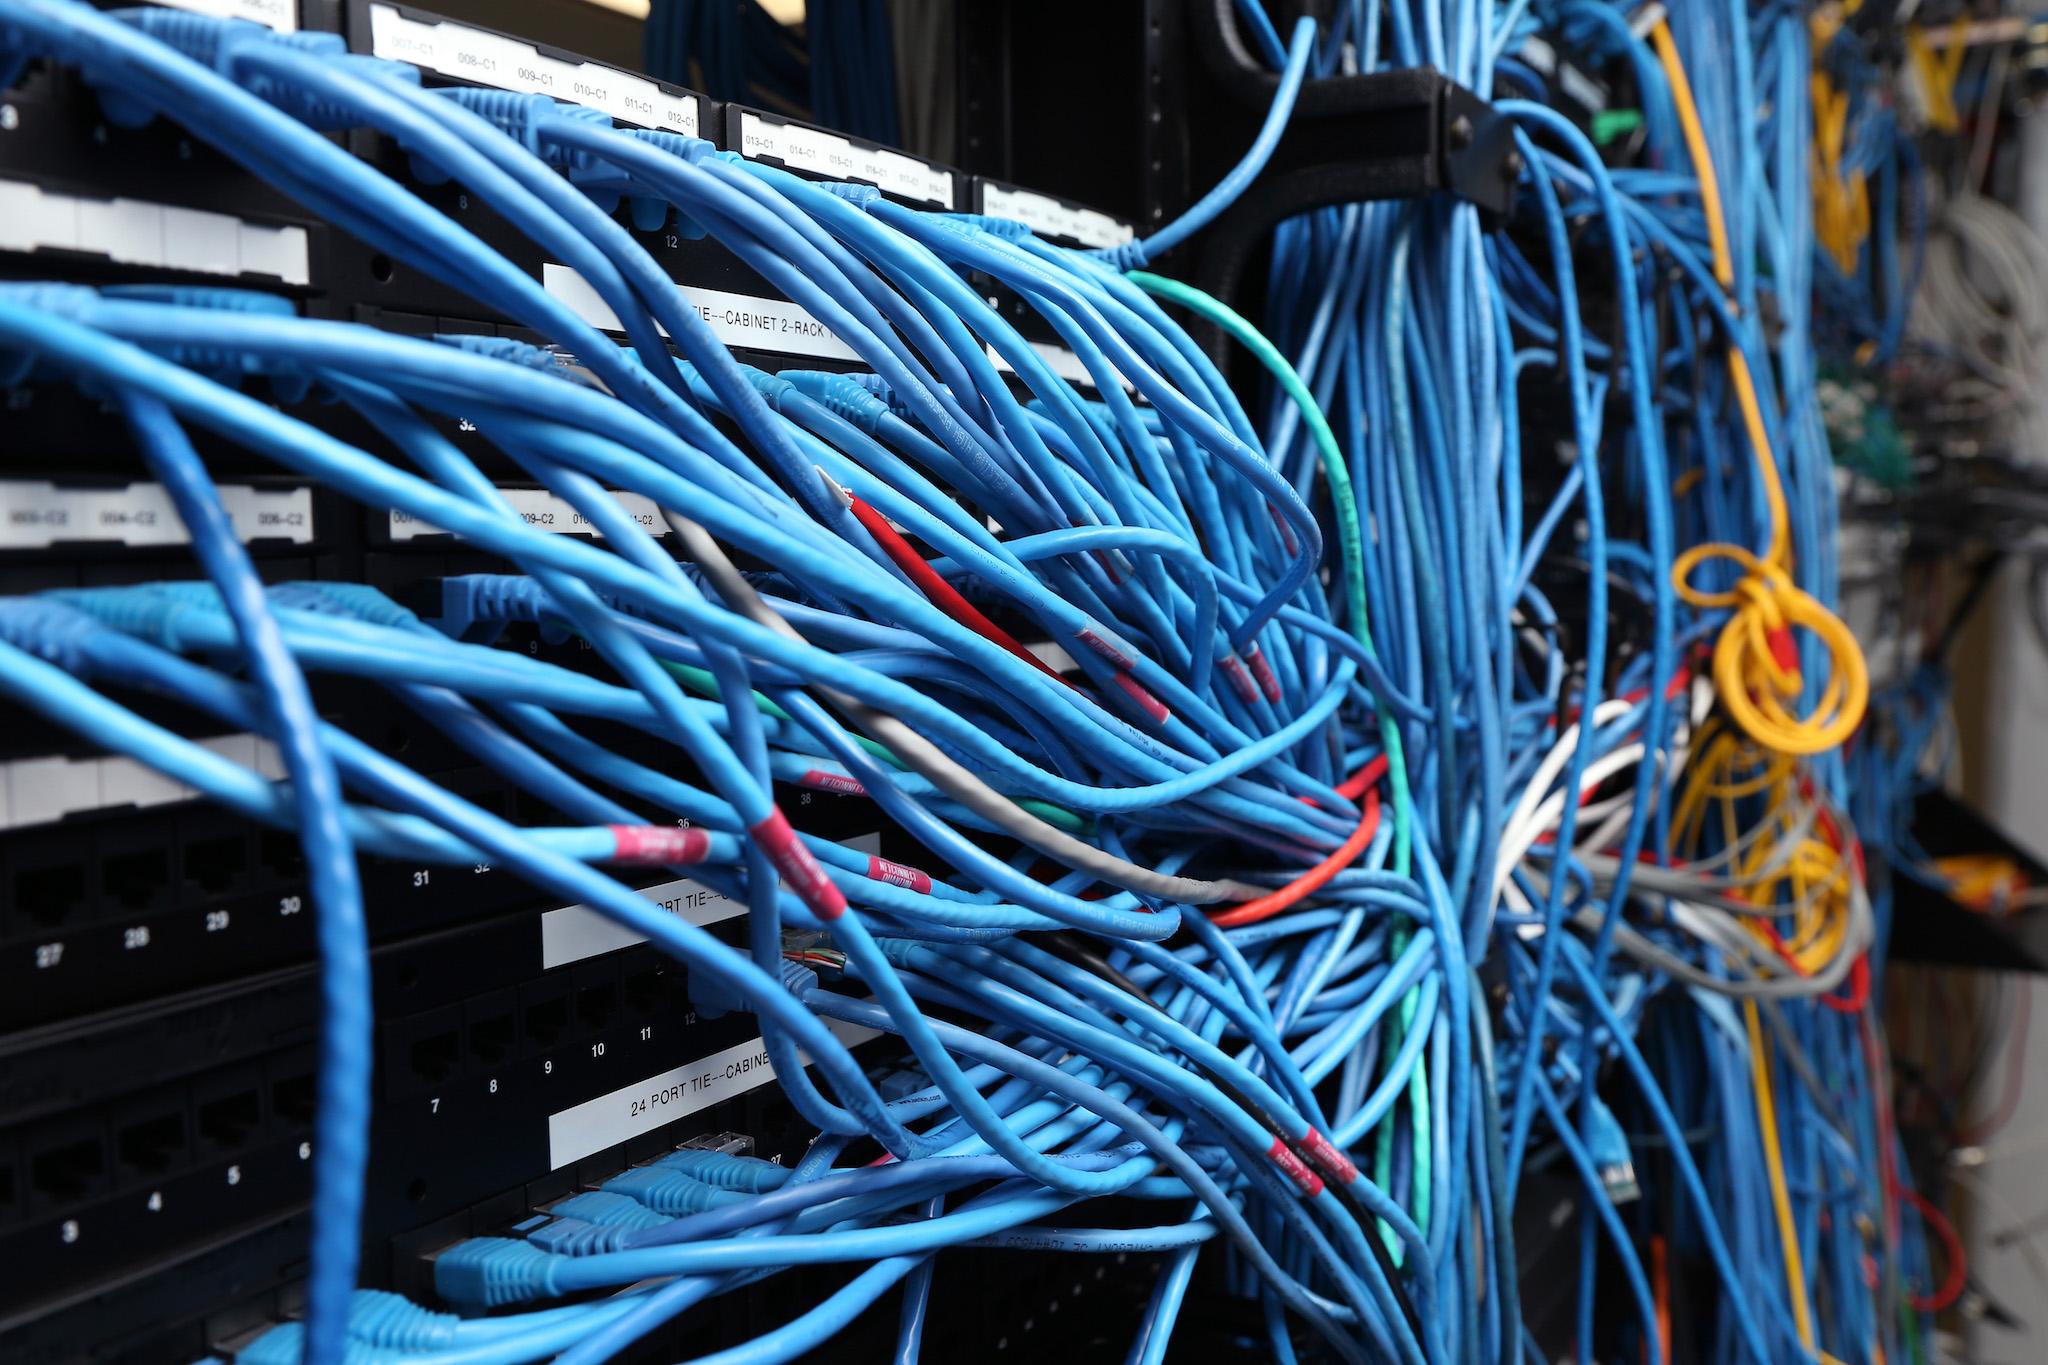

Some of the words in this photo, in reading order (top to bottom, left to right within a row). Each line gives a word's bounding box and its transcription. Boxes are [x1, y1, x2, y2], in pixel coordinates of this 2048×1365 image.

[457, 51, 496, 72] 008-C1
[517, 67, 553, 86] 009-C1
[573, 82, 607, 101] 010-C1
[624, 96, 653, 115] 011-C1
[667, 110, 695, 128] 012-C1
[745, 134, 773, 150] 013-C1
[789, 144, 817, 159] 014-C1
[665, 234, 677, 248] 12
[781, 319, 825, 338] 2-RACK
[800, 793, 811, 805] 38
[677, 817, 690, 830] 36
[413, 870, 429, 887] 31
[656, 894, 682, 915] ORT
[36, 943, 64, 968] 27
[206, 909, 229, 931] 29
[279, 896, 301, 916] 30
[430, 1097, 440, 1115] 7
[489, 1078, 498, 1094] 8
[544, 1059, 553, 1075] 9
[591, 1041, 605, 1058] 10
[640, 1025, 652, 1041] 11
[684, 1011, 696, 1025] 12
[630, 1098, 647, 1118] 24
[650, 1081, 687, 1109] PORT
[690, 1049, 770, 1094] TIE--CABINE
[61, 1219, 80, 1244] 3
[147, 1191, 163, 1213] 4
[227, 1165, 241, 1187] 5
[298, 1140, 311, 1160] 6
